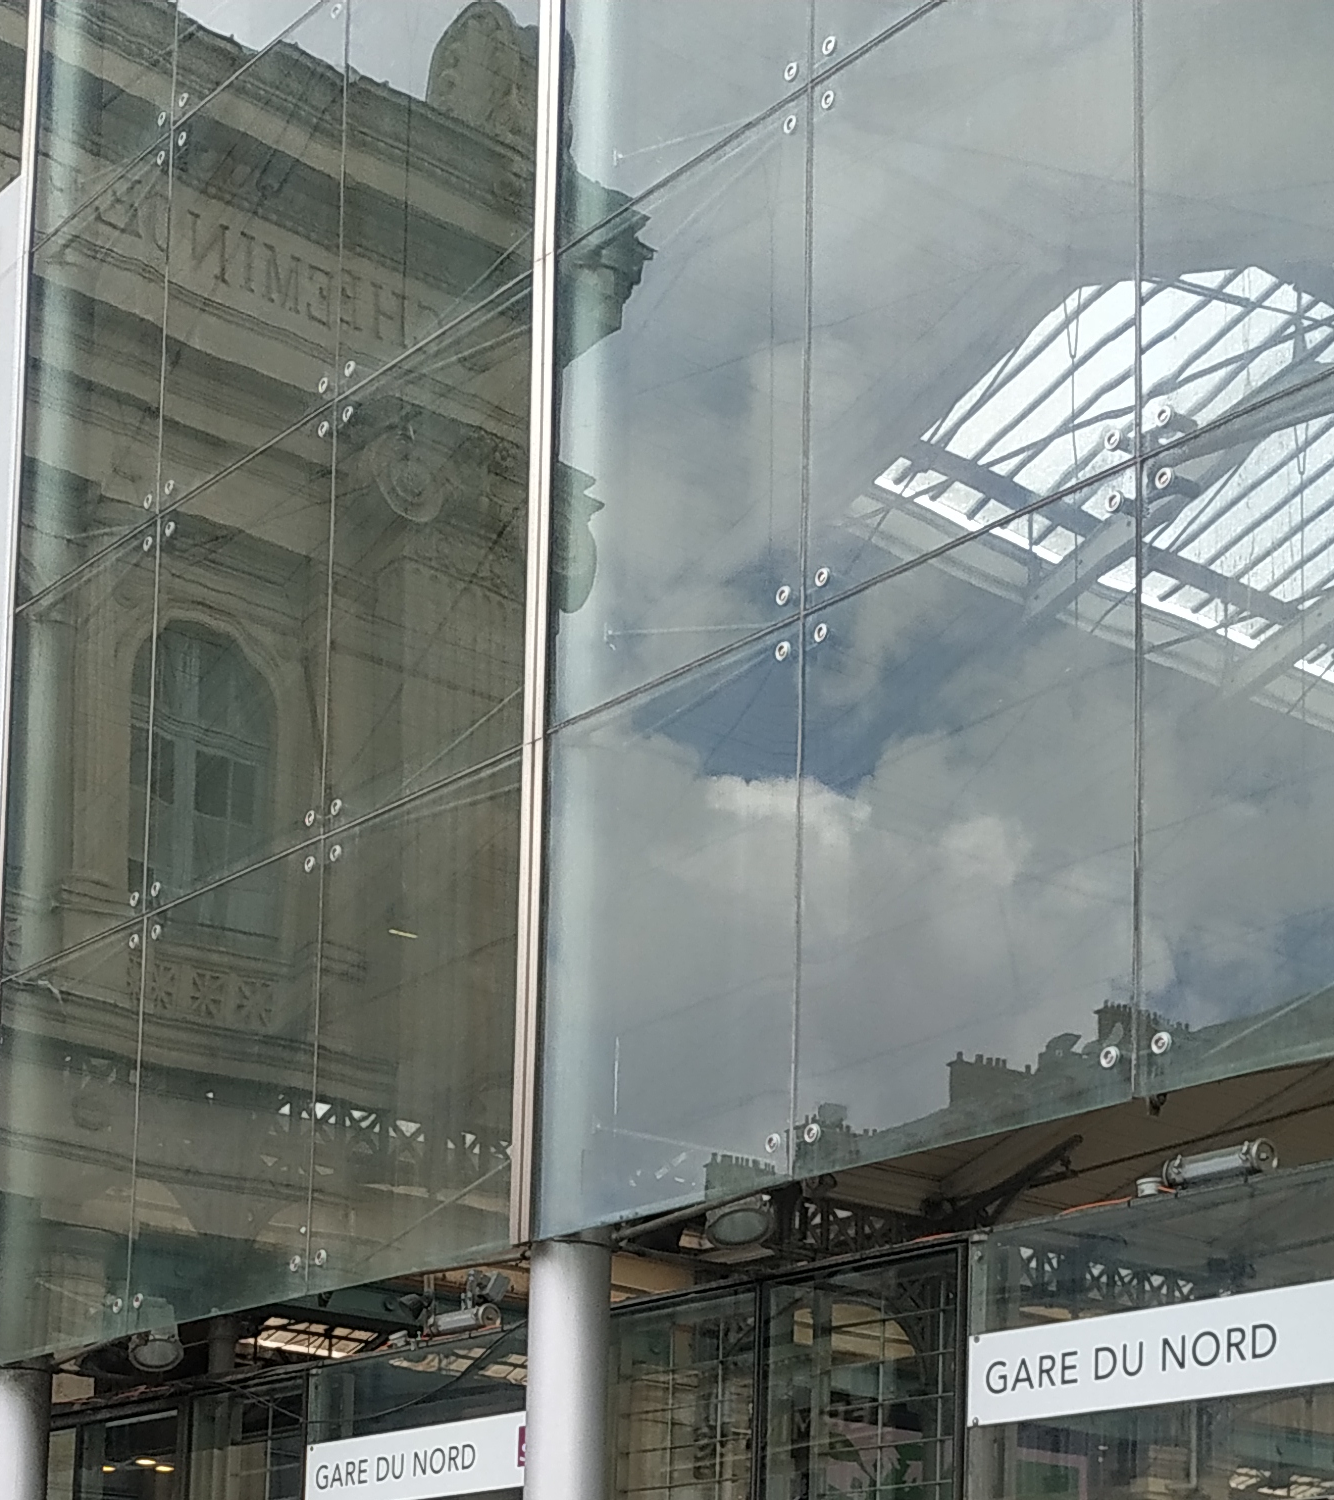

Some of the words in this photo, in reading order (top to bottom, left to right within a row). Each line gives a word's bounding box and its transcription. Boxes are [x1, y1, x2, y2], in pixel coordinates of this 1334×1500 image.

[985, 1350, 1078, 1394] GARE
[1093, 1340, 1143, 1381] DU
[1161, 1323, 1277, 1372] NORD
[315, 1458, 368, 1490] GARE
[376, 1453, 405, 1482] DU
[412, 1443, 476, 1478] NORD
